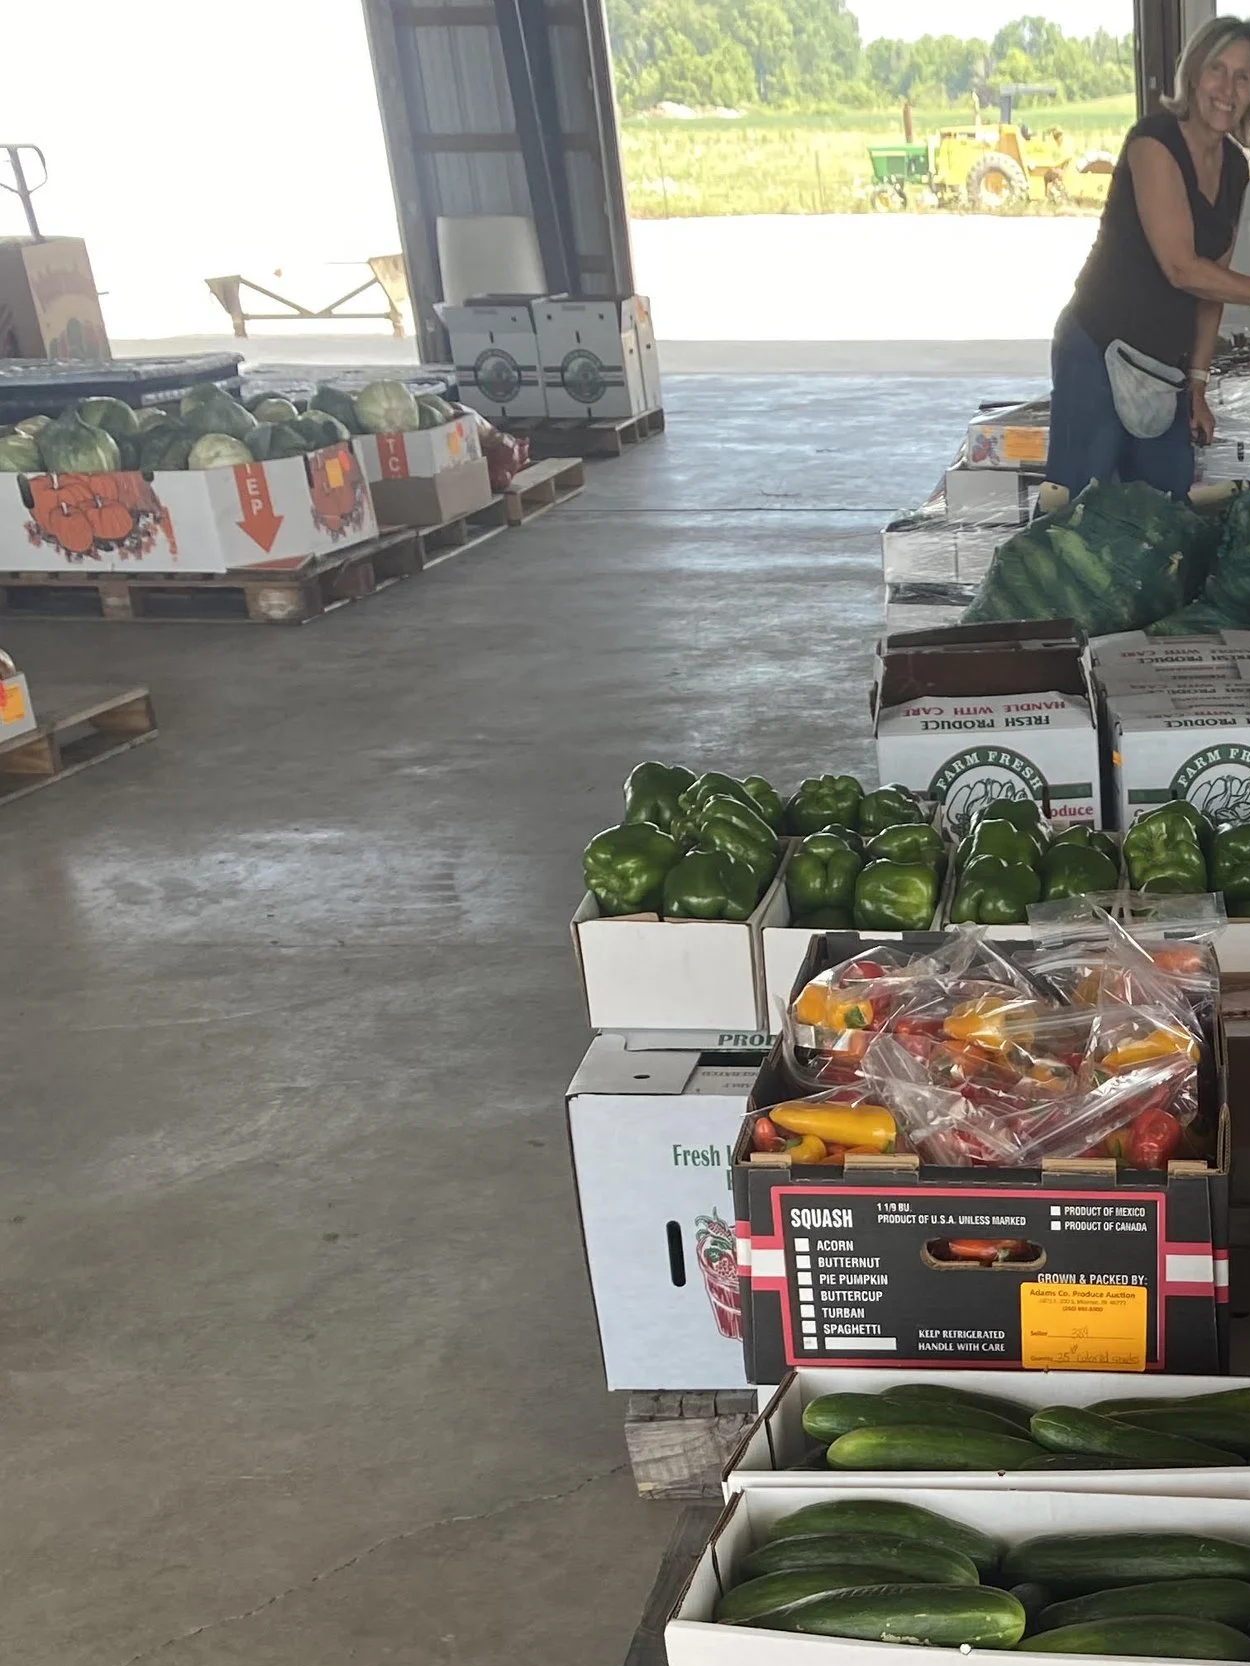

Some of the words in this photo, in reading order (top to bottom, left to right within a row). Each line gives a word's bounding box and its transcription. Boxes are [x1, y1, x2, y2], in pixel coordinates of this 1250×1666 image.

[1004, 701, 1066, 713] HANDLE
[920, 717, 996, 731] PRODUCE
[1004, 715, 1050, 727] FRESH
[1164, 718, 1238, 728] PRODUCE
[936, 751, 981, 791] FARM
[987, 750, 1044, 791] FRESH
[1180, 749, 1222, 788] FARM
[672, 1144, 721, 1167] Fresh
[1064, 1206, 1101, 1216] PRODUCT
[1103, 1207, 1114, 1216] OF
[1115, 1207, 1146, 1217] MEXICO
[790, 1208, 853, 1230] SQUASH
[877, 1214, 917, 1224] PRODUCT
[918, 1215, 929, 1224] OF
[958, 1215, 991, 1225] UNLESS
[992, 1216, 1026, 1226] MARKED
[1064, 1221, 1101, 1231] PRODUCT
[1103, 1222, 1114, 1231] OF
[1115, 1222, 1147, 1232] CANADA
[816, 1240, 854, 1251] ACORN
[818, 1257, 881, 1268] BUTTERNUT
[820, 1274, 837, 1285] PIE
[839, 1274, 888, 1285] PUMPKIN
[1037, 1273, 1076, 1284] GROWN
[1079, 1274, 1086, 1284] &
[1090, 1274, 1129, 1285] PACKED
[1131, 1275, 1149, 1286] BY:
[820, 1291, 883, 1302] BUTTERCUP
[822, 1307, 865, 1318] TURBAN
[823, 1324, 881, 1335] SPAGHETTI
[918, 1329, 940, 1339] KEEP
[942, 1330, 1006, 1340] REFRIGERATED
[918, 1342, 954, 1352] HANDLE
[956, 1342, 979, 1352] WITH
[981, 1342, 1006, 1352] CARE
